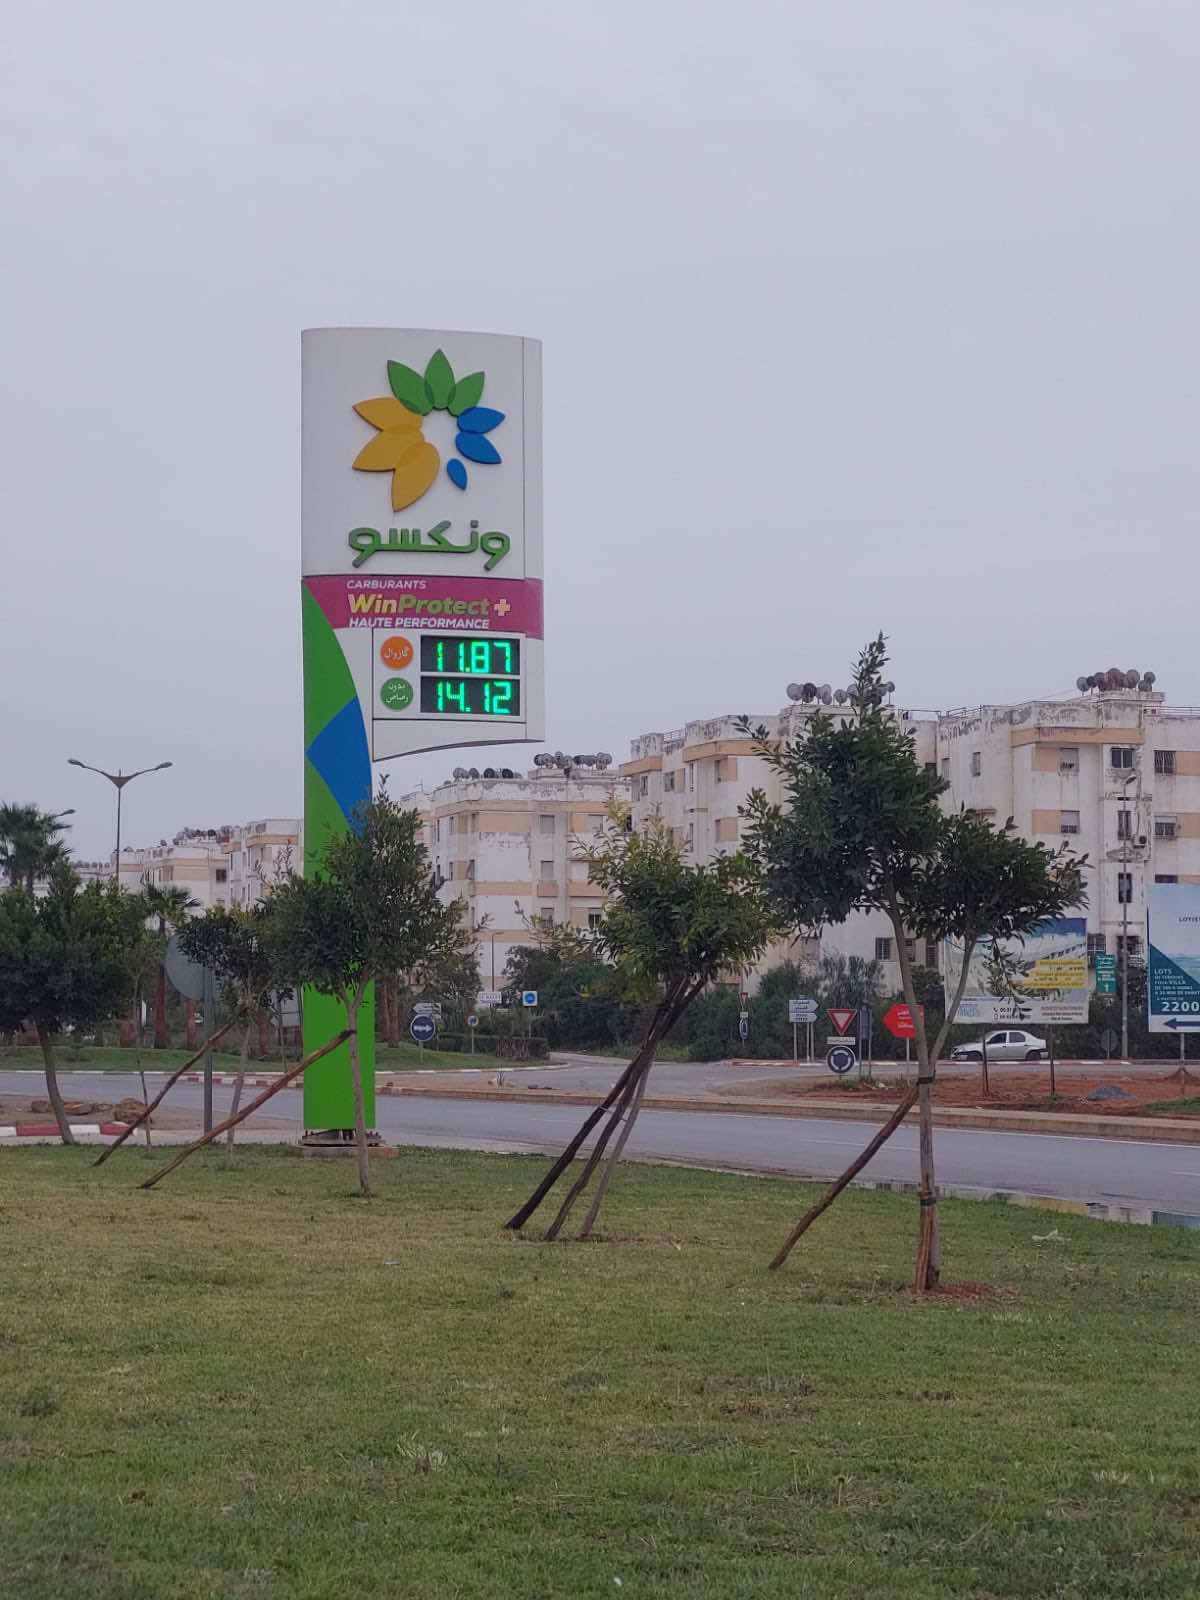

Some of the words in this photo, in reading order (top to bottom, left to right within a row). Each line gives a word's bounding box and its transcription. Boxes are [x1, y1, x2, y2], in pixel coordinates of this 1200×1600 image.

[346, 579, 427, 590] CARBURANTS
[349, 617, 392, 628] HAUTE
[394, 617, 490, 630] PERFORMANCE
[437, 641, 512, 673] 11.87
